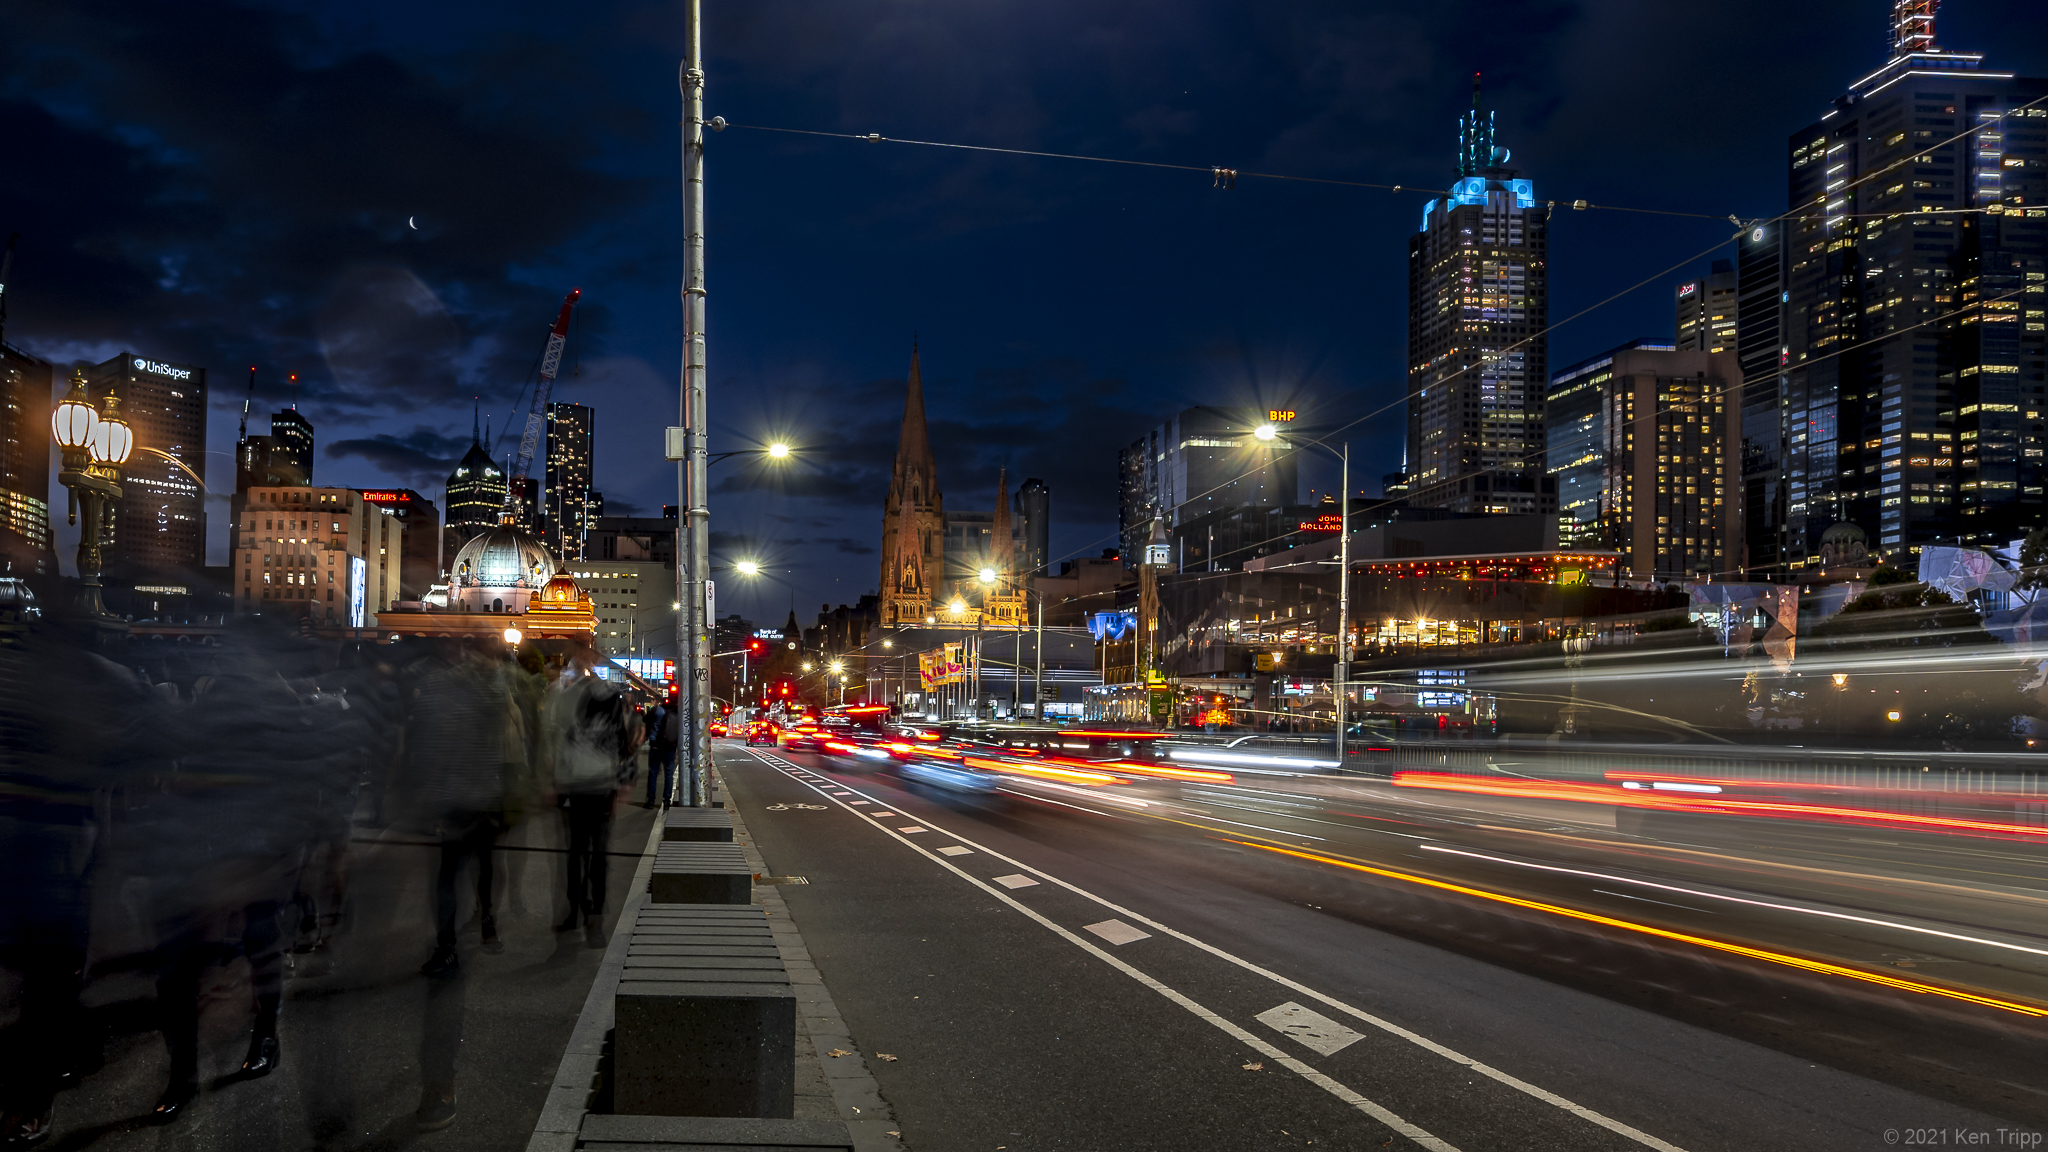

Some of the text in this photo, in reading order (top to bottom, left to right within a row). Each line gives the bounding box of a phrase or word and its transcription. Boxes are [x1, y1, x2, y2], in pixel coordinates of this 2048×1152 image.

[147, 360, 190, 379] UniSuper
[1270, 410, 1295, 421] BHP
[363, 491, 396, 501] Emirates
[1300, 523, 1342, 531] HOLLAND
